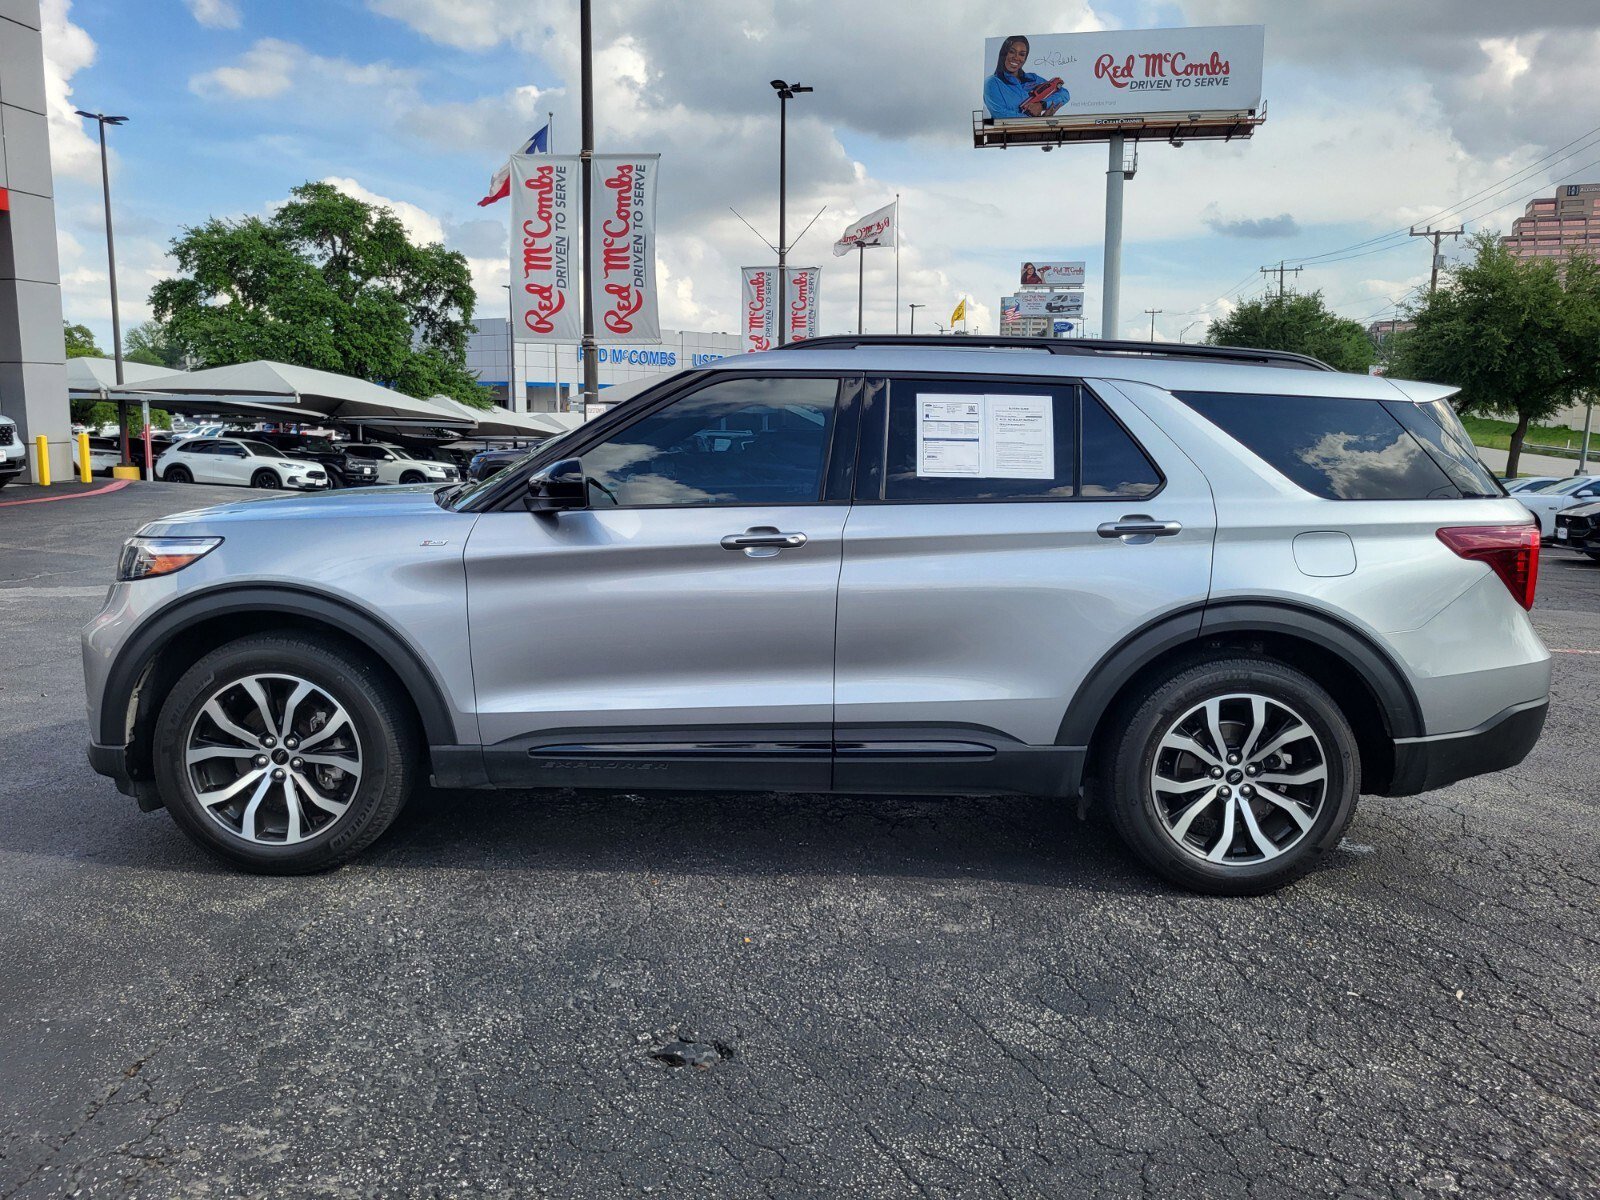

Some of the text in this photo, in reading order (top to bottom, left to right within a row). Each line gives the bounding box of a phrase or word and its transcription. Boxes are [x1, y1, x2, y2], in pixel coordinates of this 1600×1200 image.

[1094, 52, 1230, 89] Red McCombs
[1130, 77, 1230, 90] DRIVEN TO SERVE
[523, 165, 566, 334] Red McCombs
[555, 165, 567, 289] DRIVEN TO SERVE
[602, 164, 643, 334] Red McCombs
[633, 164, 646, 288] DRIVEN TO SERVE
[748, 272, 765, 333] McCombs
[765, 297, 772, 307] TO
[791, 272, 808, 333] McCombs
[808, 297, 815, 307] TO
[611, 349, 677, 367] McCOMBS
[541, 762, 669, 770] EXPLORER
